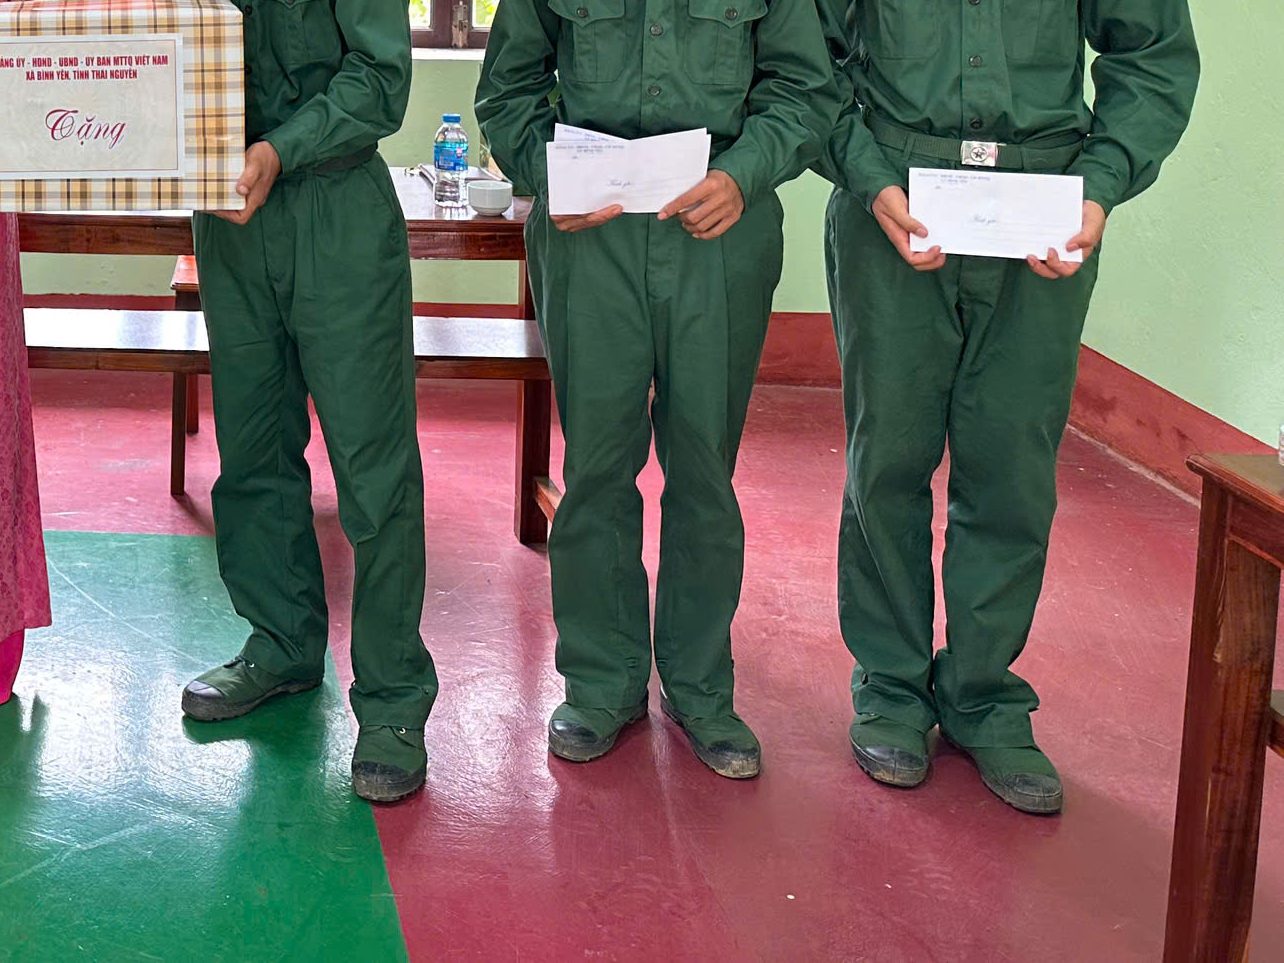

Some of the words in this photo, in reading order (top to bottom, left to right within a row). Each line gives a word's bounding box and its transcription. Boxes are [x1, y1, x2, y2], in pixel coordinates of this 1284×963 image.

[58, 56, 78, 67] UBND
[97, 56, 110, 66] BAN
[114, 56, 132, 66] MTTQ
[152, 55, 168, 65] NAM
[37, 69, 54, 80] BÌNH
[110, 67, 137, 79] NGUYÊN
[45, 108, 125, 149] Tặng
